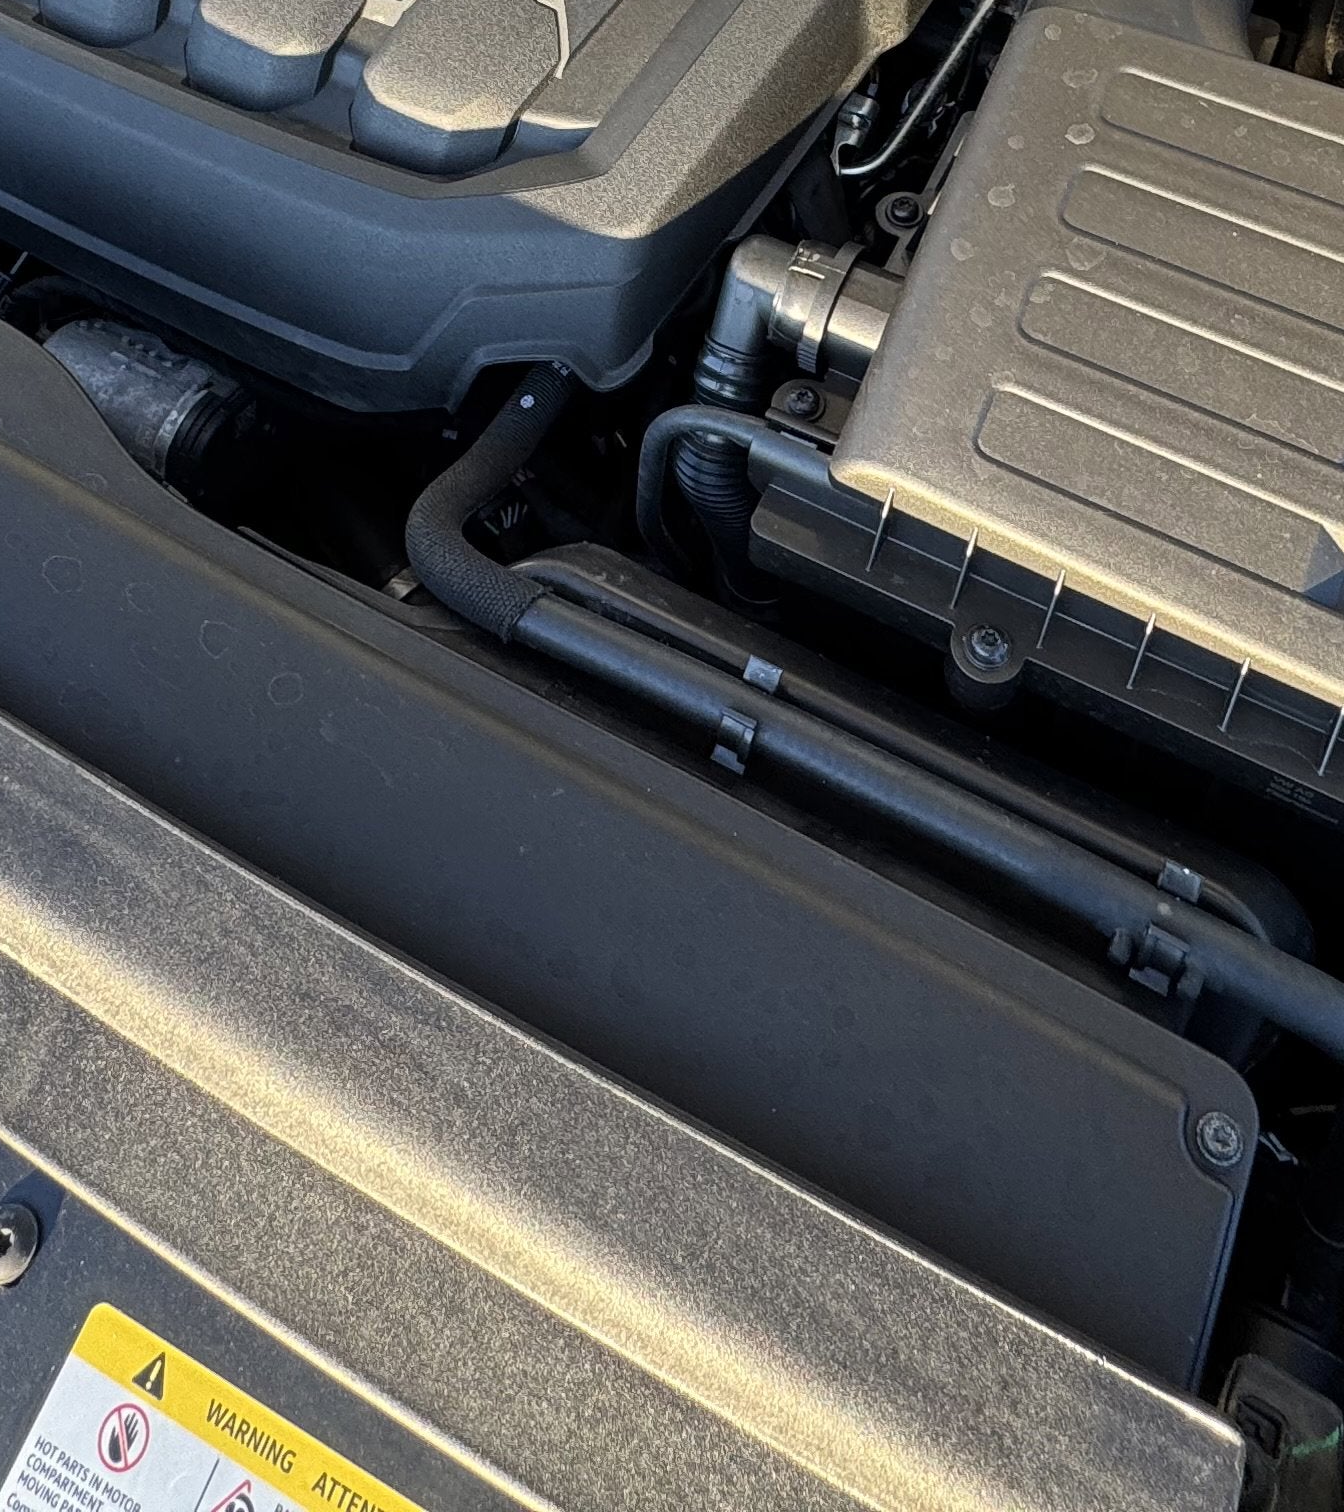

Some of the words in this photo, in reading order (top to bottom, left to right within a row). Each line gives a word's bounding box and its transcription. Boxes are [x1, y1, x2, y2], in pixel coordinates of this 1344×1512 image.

[26, 1453, 104, 1512] COMPARTMENT
[35, 1436, 58, 1459] HOT
[57, 1451, 90, 1483] PARTS
[88, 1472, 104, 1492] IN
[102, 1482, 142, 1512] MOTOR
[206, 1398, 297, 1474] WARNING
[312, 1472, 385, 1512] ATTEN
[17, 1470, 61, 1508] MOVING
